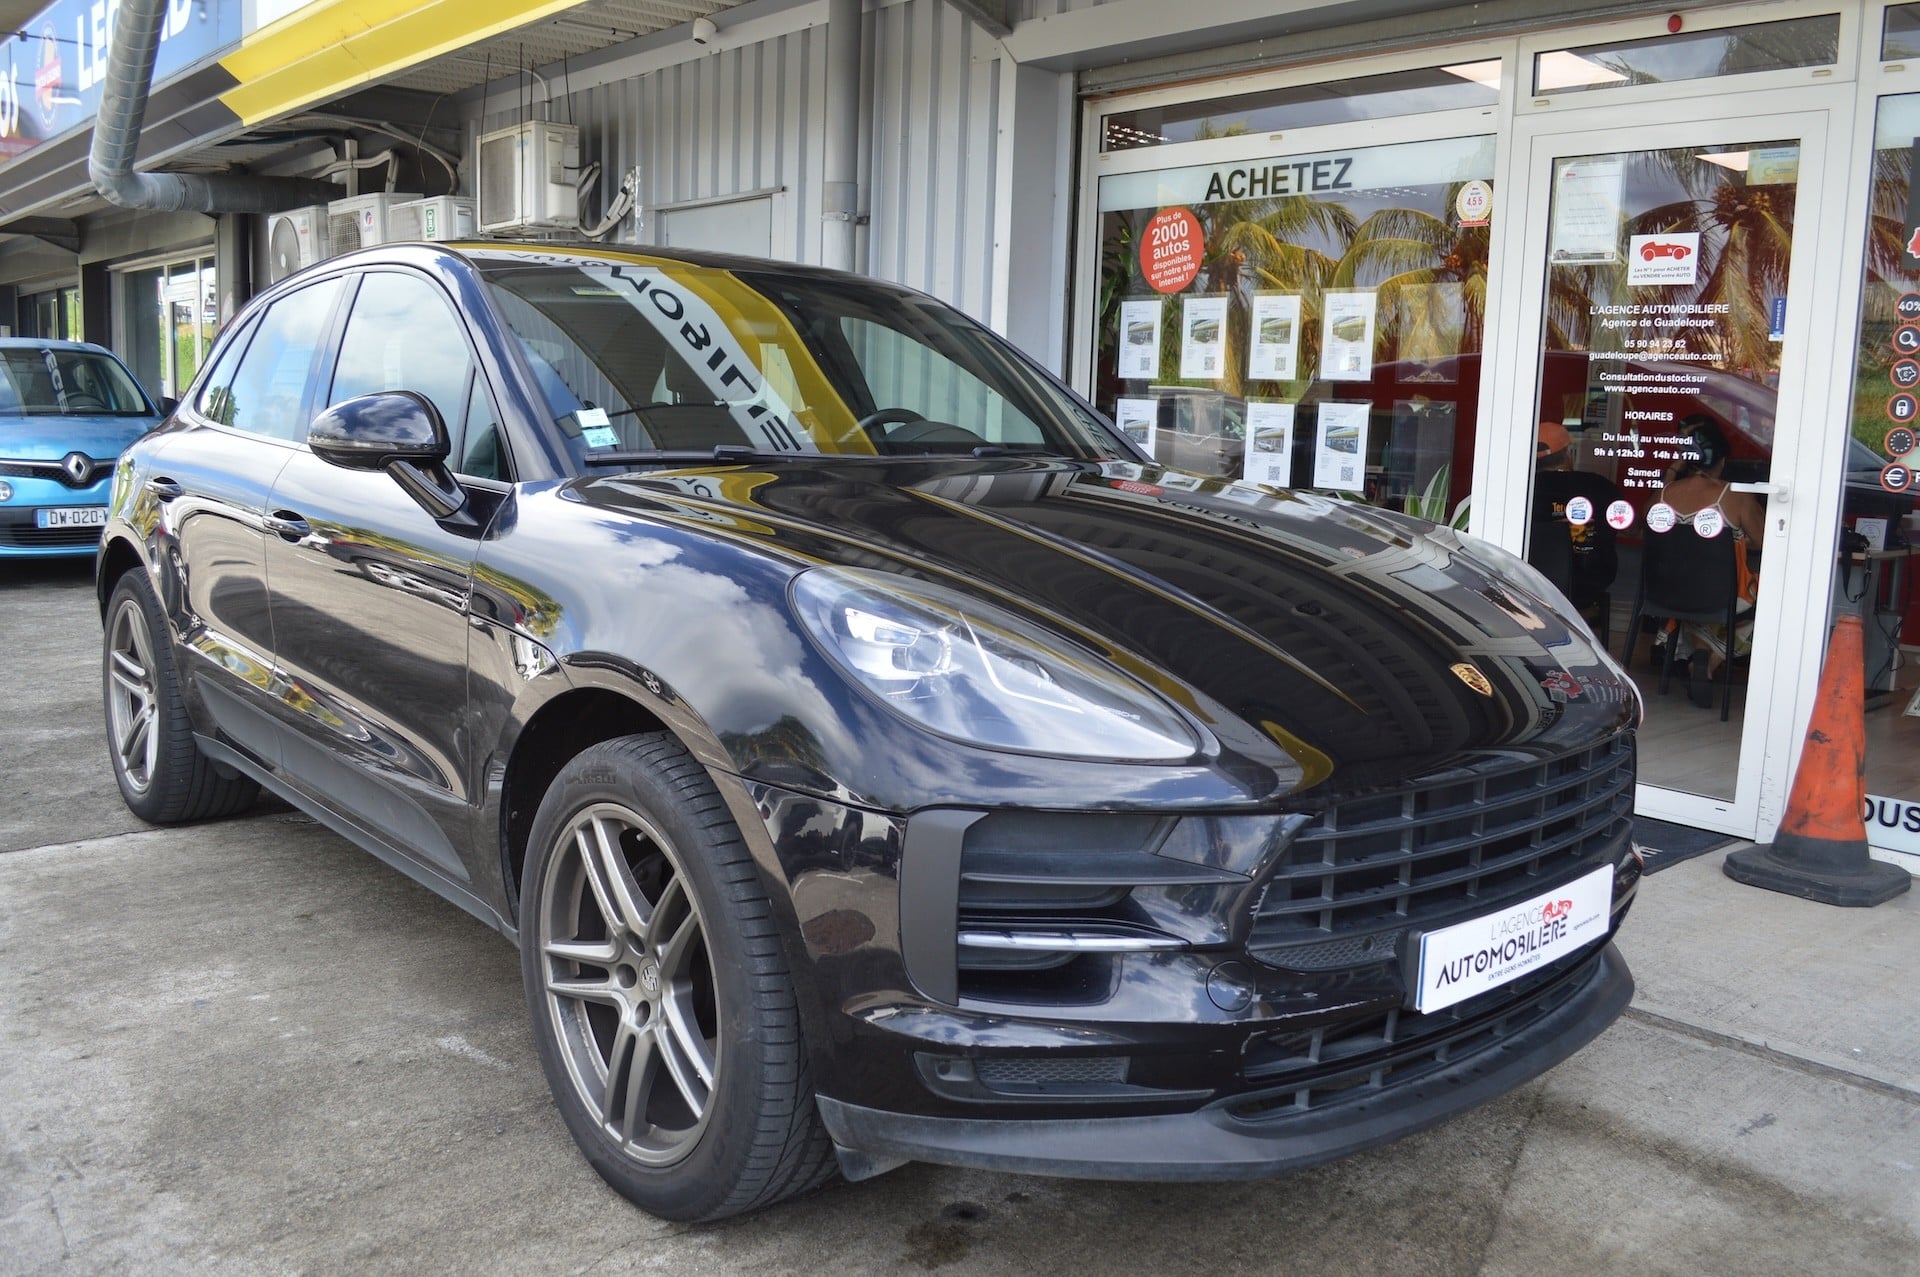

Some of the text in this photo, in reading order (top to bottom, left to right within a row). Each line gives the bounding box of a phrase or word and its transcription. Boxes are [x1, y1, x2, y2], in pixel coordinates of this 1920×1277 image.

[1205, 157, 1353, 200] ACHETEZ
[1156, 211, 1182, 225] Plus de
[1151, 219, 1188, 246] 2000
[1153, 239, 1190, 260] autos
[1152, 254, 1192, 270] disponibles
[1151, 262, 1195, 281] sur notre site
[1590, 304, 1729, 315] L'AGENCE AUTOMOBILIERE
[1601, 318, 1714, 329] Agence de Guadeloupe
[1624, 340, 1635, 348] 05
[1637, 340, 1647, 348] 90
[1649, 340, 1660, 348] 94
[1662, 340, 1673, 348] 23
[1589, 351, 1722, 362] guadeloupe@agenceauto.com
[1604, 385, 1700, 395] www.agenceauto.com
[1625, 411, 1673, 421] HORAIRES
[1603, 433, 1615, 441] Du
[1617, 433, 1638, 442] lundi
[1653, 436, 1693, 445] vendredi
[1594, 448, 1700, 460] 9h à 12h30 14h à 17h
[1628, 467, 1660, 477] Samedi
[1624, 479, 1664, 488] 9h à 12h
[1491, 905, 1544, 941] L'AGENCE
